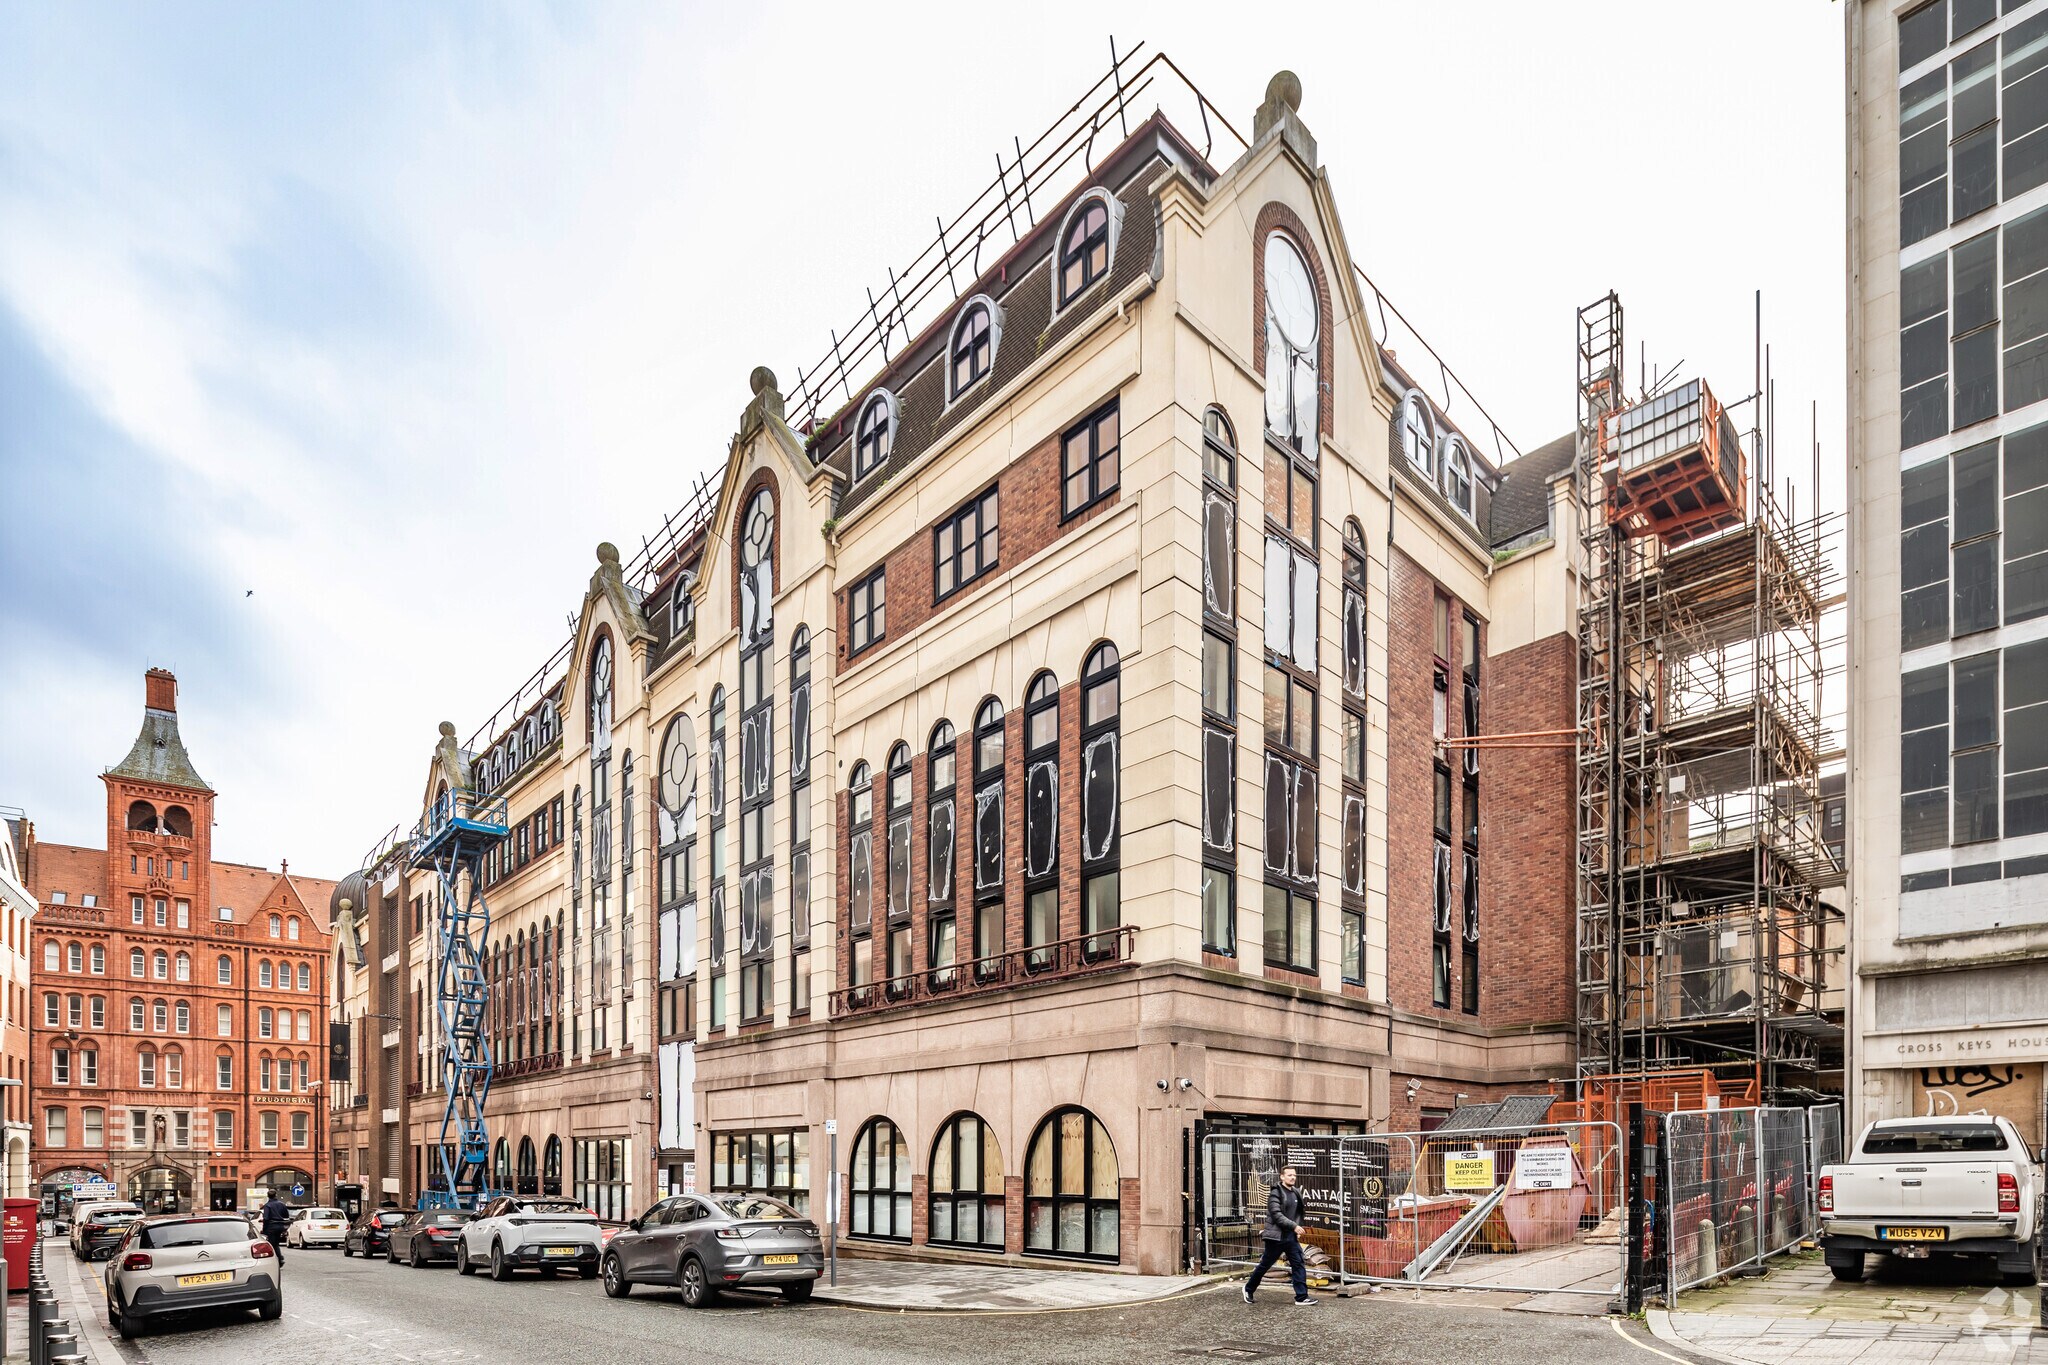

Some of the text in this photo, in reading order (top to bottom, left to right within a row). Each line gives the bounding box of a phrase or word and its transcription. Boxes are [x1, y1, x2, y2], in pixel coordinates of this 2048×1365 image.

[1898, 1043, 1942, 1054] CROSS
[1958, 1040, 1992, 1050] KEYS
[1888, 1228, 1942, 1237] WU65 VZV
[183, 1274, 227, 1284] MT24 XBU
